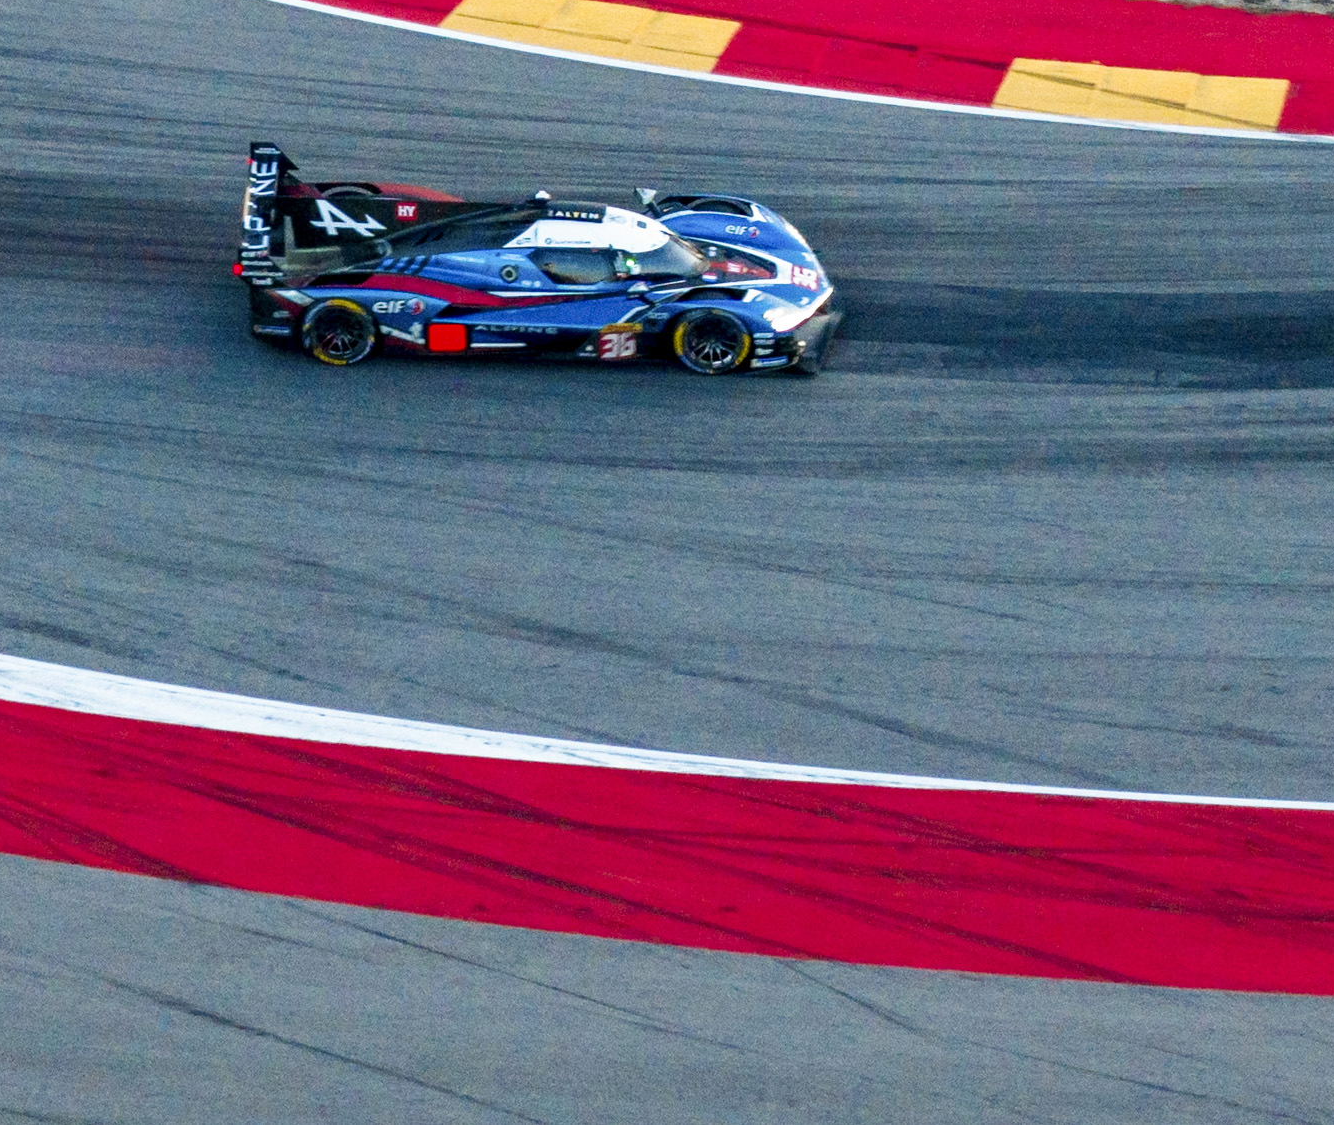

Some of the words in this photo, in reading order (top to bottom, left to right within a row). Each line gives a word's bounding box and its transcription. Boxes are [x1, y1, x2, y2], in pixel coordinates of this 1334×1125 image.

[398, 205, 416, 217] HY
[725, 225, 748, 235] elf
[372, 300, 406, 314] elf
[601, 332, 636, 359] 36
